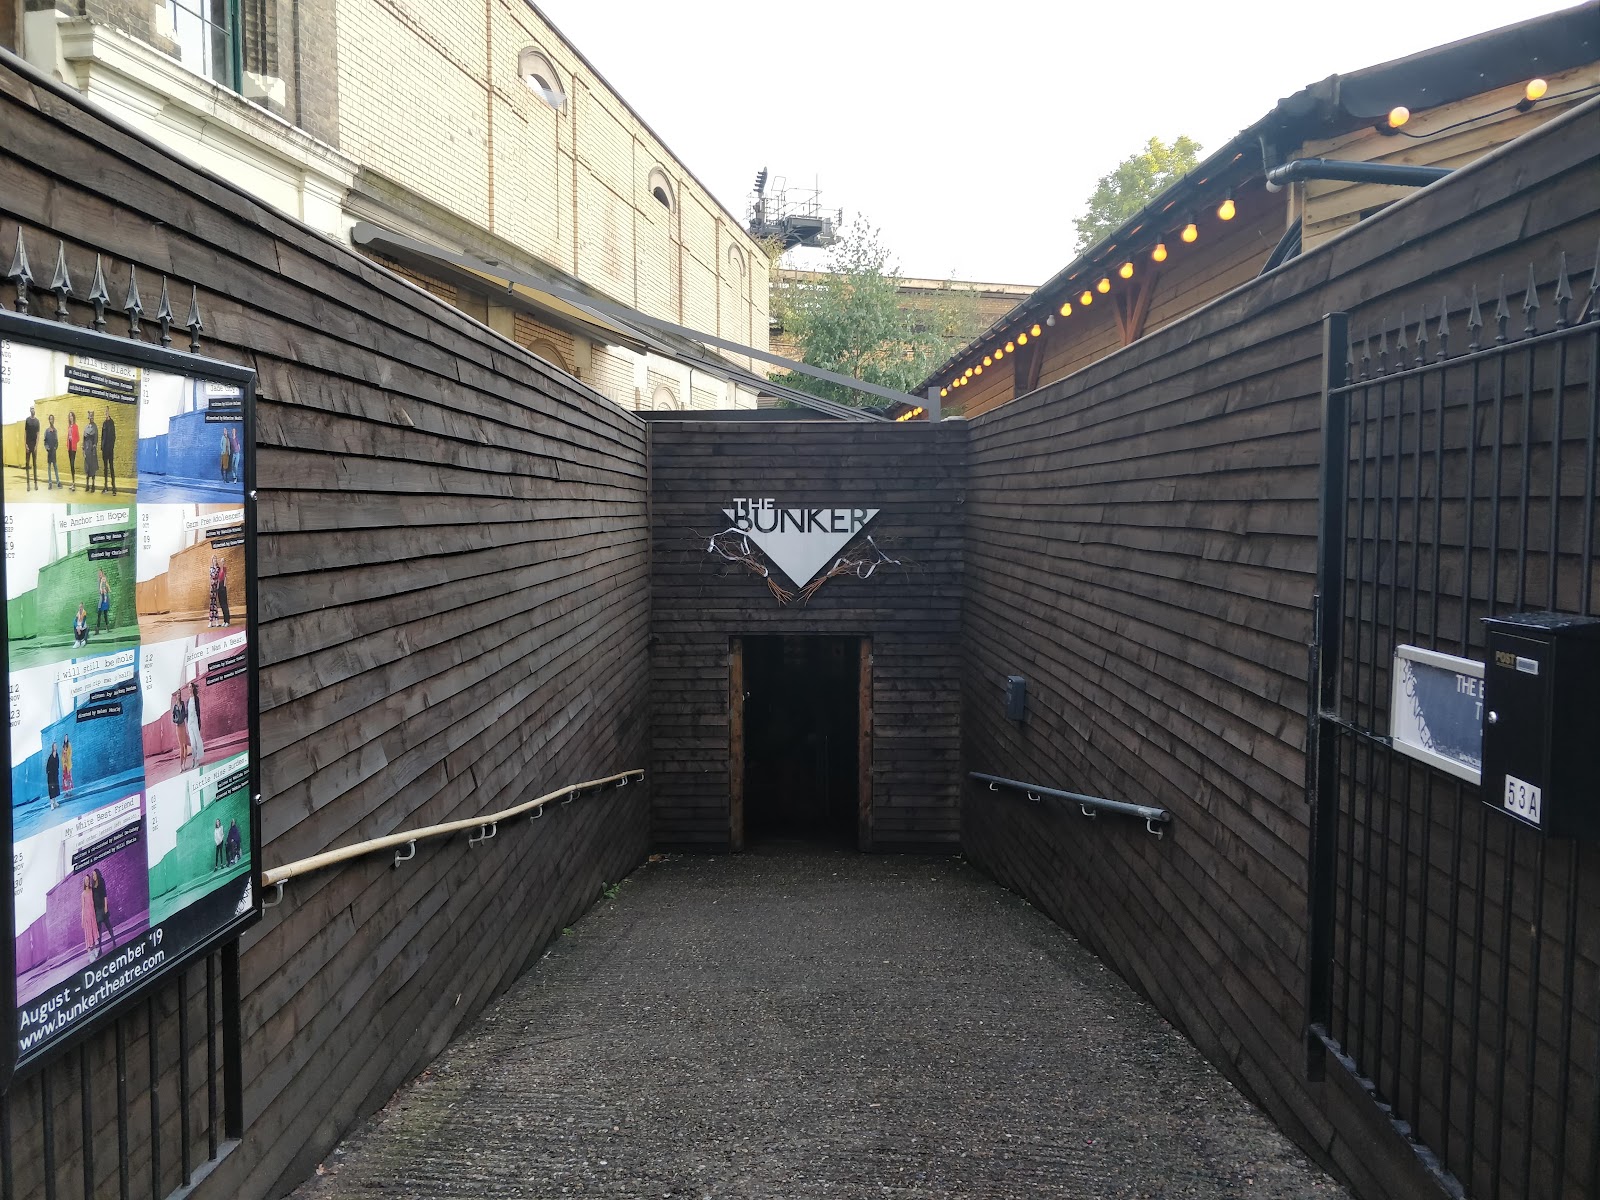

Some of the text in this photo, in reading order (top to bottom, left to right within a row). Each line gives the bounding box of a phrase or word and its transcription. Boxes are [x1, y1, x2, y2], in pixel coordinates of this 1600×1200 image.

[1, 366, 12, 376] 25
[101, 362, 108, 371] is
[111, 363, 135, 378] Black.
[733, 498, 775, 510] THE
[5, 516, 14, 525] 25
[59, 511, 129, 528] We Anchor in Hope.
[735, 508, 869, 533] BUNKER
[229, 636, 244, 646] Bear.
[1495, 651, 1515, 665] POST
[62, 667, 80, 679] will
[83, 661, 100, 673] still
[105, 658, 115, 667] be
[9, 684, 20, 693] 12
[1456, 674, 1477, 697] THE
[10, 709, 21, 719] 23
[192, 776, 210, 791] Little
[1508, 782, 1538, 818] 53A
[76, 819, 95, 832] White
[96, 812, 112, 823] Best
[114, 798, 135, 814] Friend
[14, 852, 23, 863] 25
[14, 878, 23, 889] 30
[20, 988, 71, 1031] August
[84, 942, 146, 990] December
[19, 950, 165, 1051] www.bunkertheatre.com
